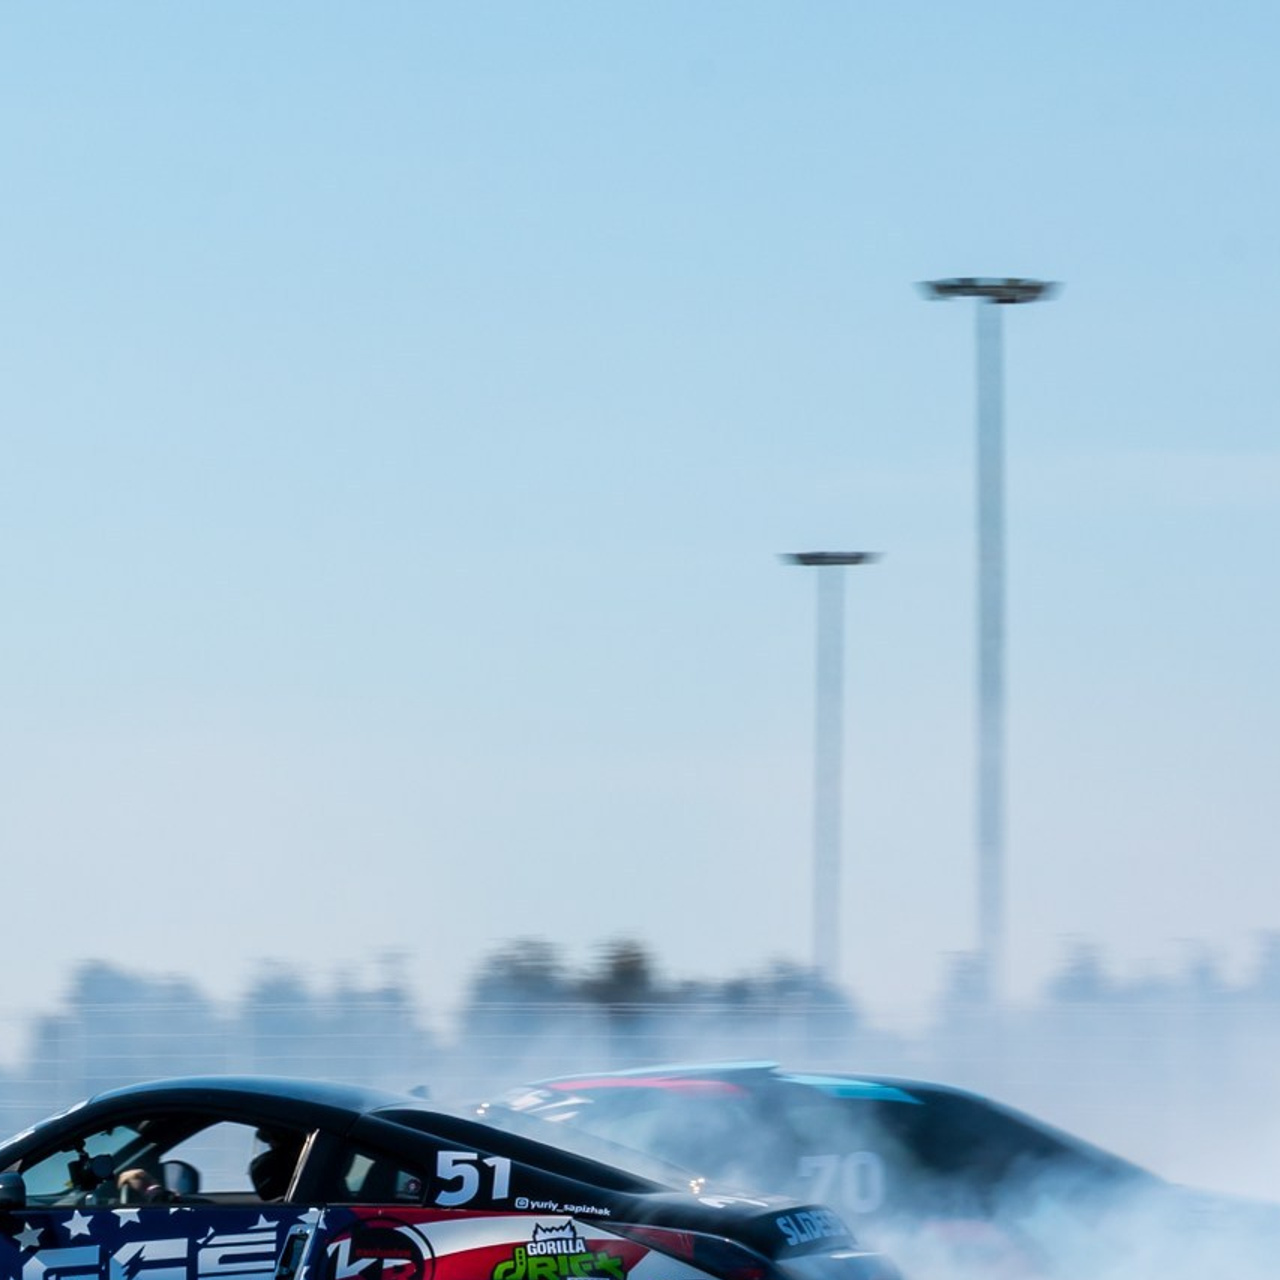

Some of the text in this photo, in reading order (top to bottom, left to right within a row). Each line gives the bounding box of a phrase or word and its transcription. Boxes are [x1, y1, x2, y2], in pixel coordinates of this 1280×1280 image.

[435, 1150, 511, 1207] 51
[798, 1152, 886, 1213] 70
[530, 1199, 611, 1216] yuriy_sapizhak
[527, 1239, 586, 1256] GORILLA
